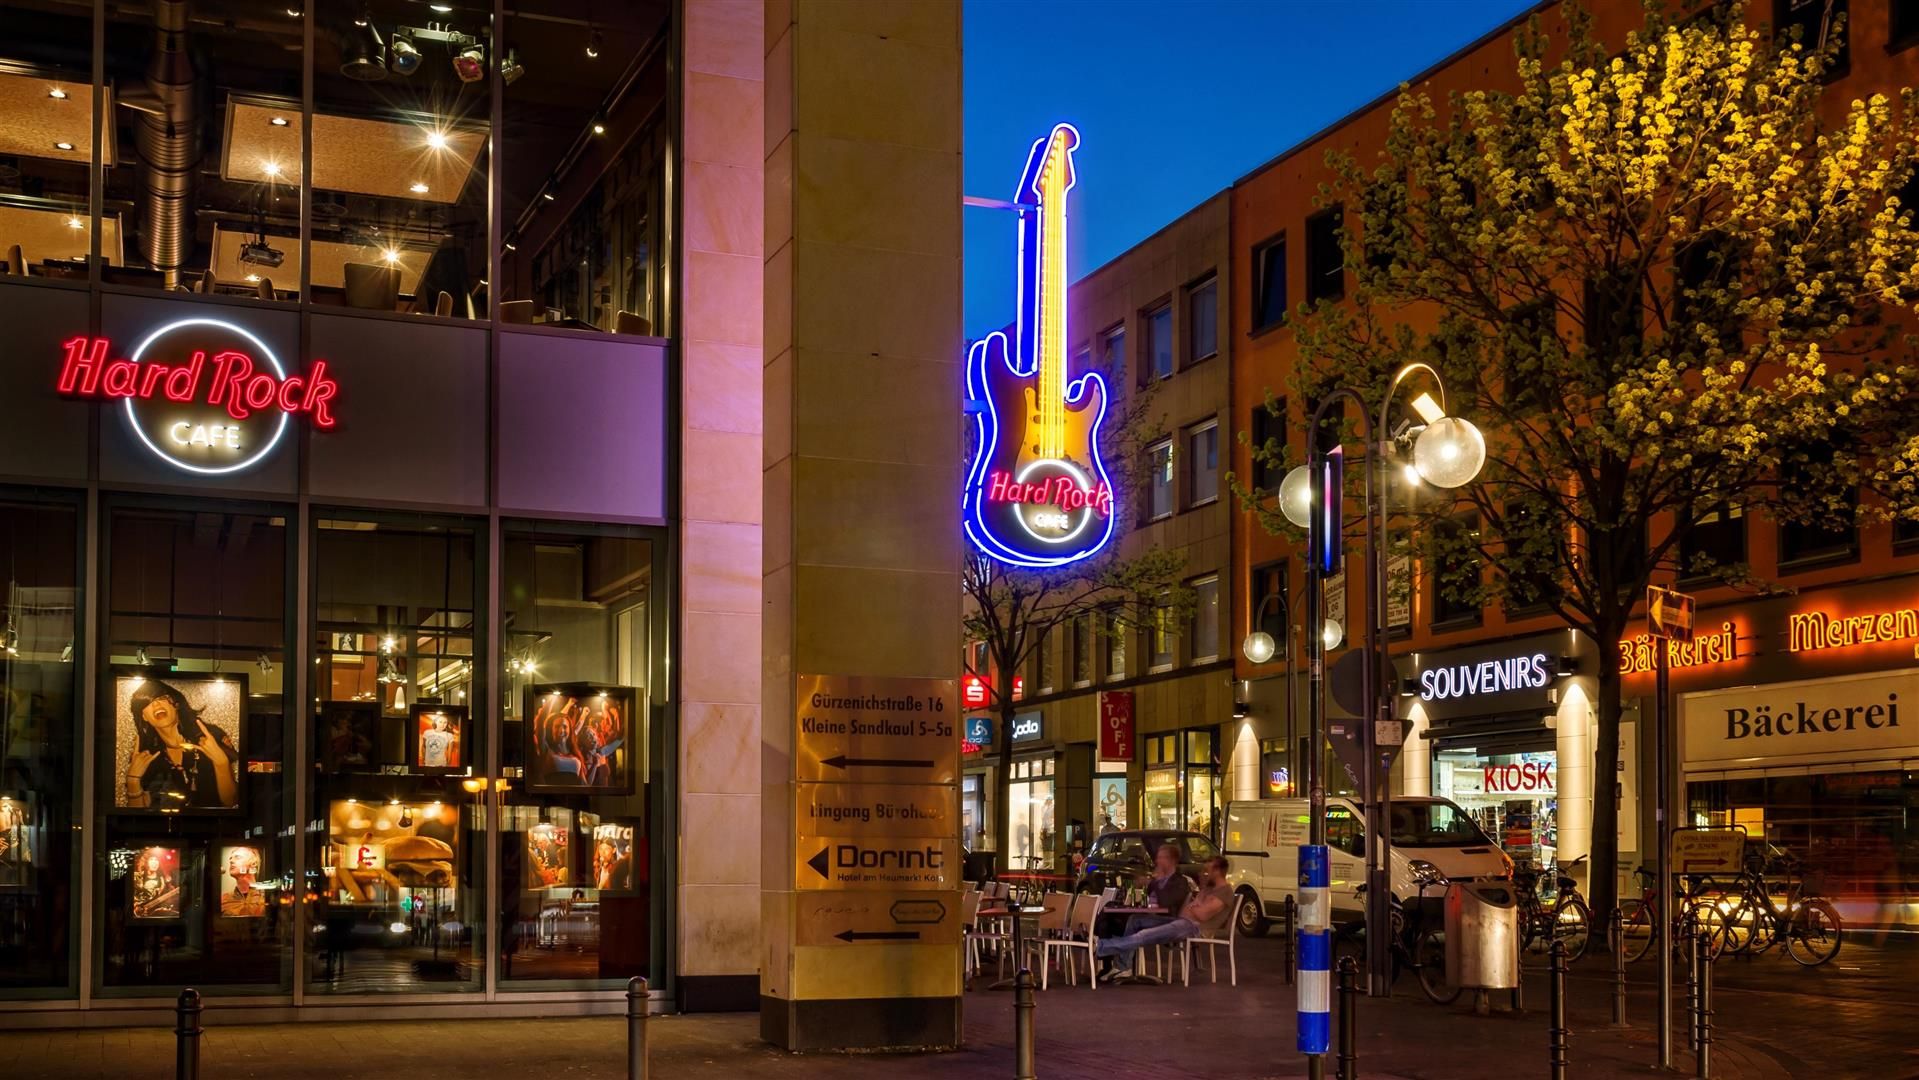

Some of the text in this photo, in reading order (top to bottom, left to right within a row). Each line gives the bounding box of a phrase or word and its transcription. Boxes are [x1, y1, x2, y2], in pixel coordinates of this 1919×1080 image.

[58, 337, 337, 426] Hard Rock
[170, 421, 241, 450] CAFE
[989, 472, 1110, 515] Hard Rock
[1034, 513, 1069, 530] CAFE
[1619, 622, 1734, 674] Bäkerei
[1790, 609, 1918, 652] Merzen
[1421, 654, 1546, 701] SOUVENIRS
[811, 693, 943, 712] Gürzenichstraße 16
[1724, 693, 1900, 740] Bäckerei
[802, 717, 846, 734] Kleine
[851, 719, 914, 736] Sandkaul
[1484, 762, 1553, 793] KIOSK
[838, 874, 861, 882] Hotel
[879, 874, 921, 883] Heumarkt
